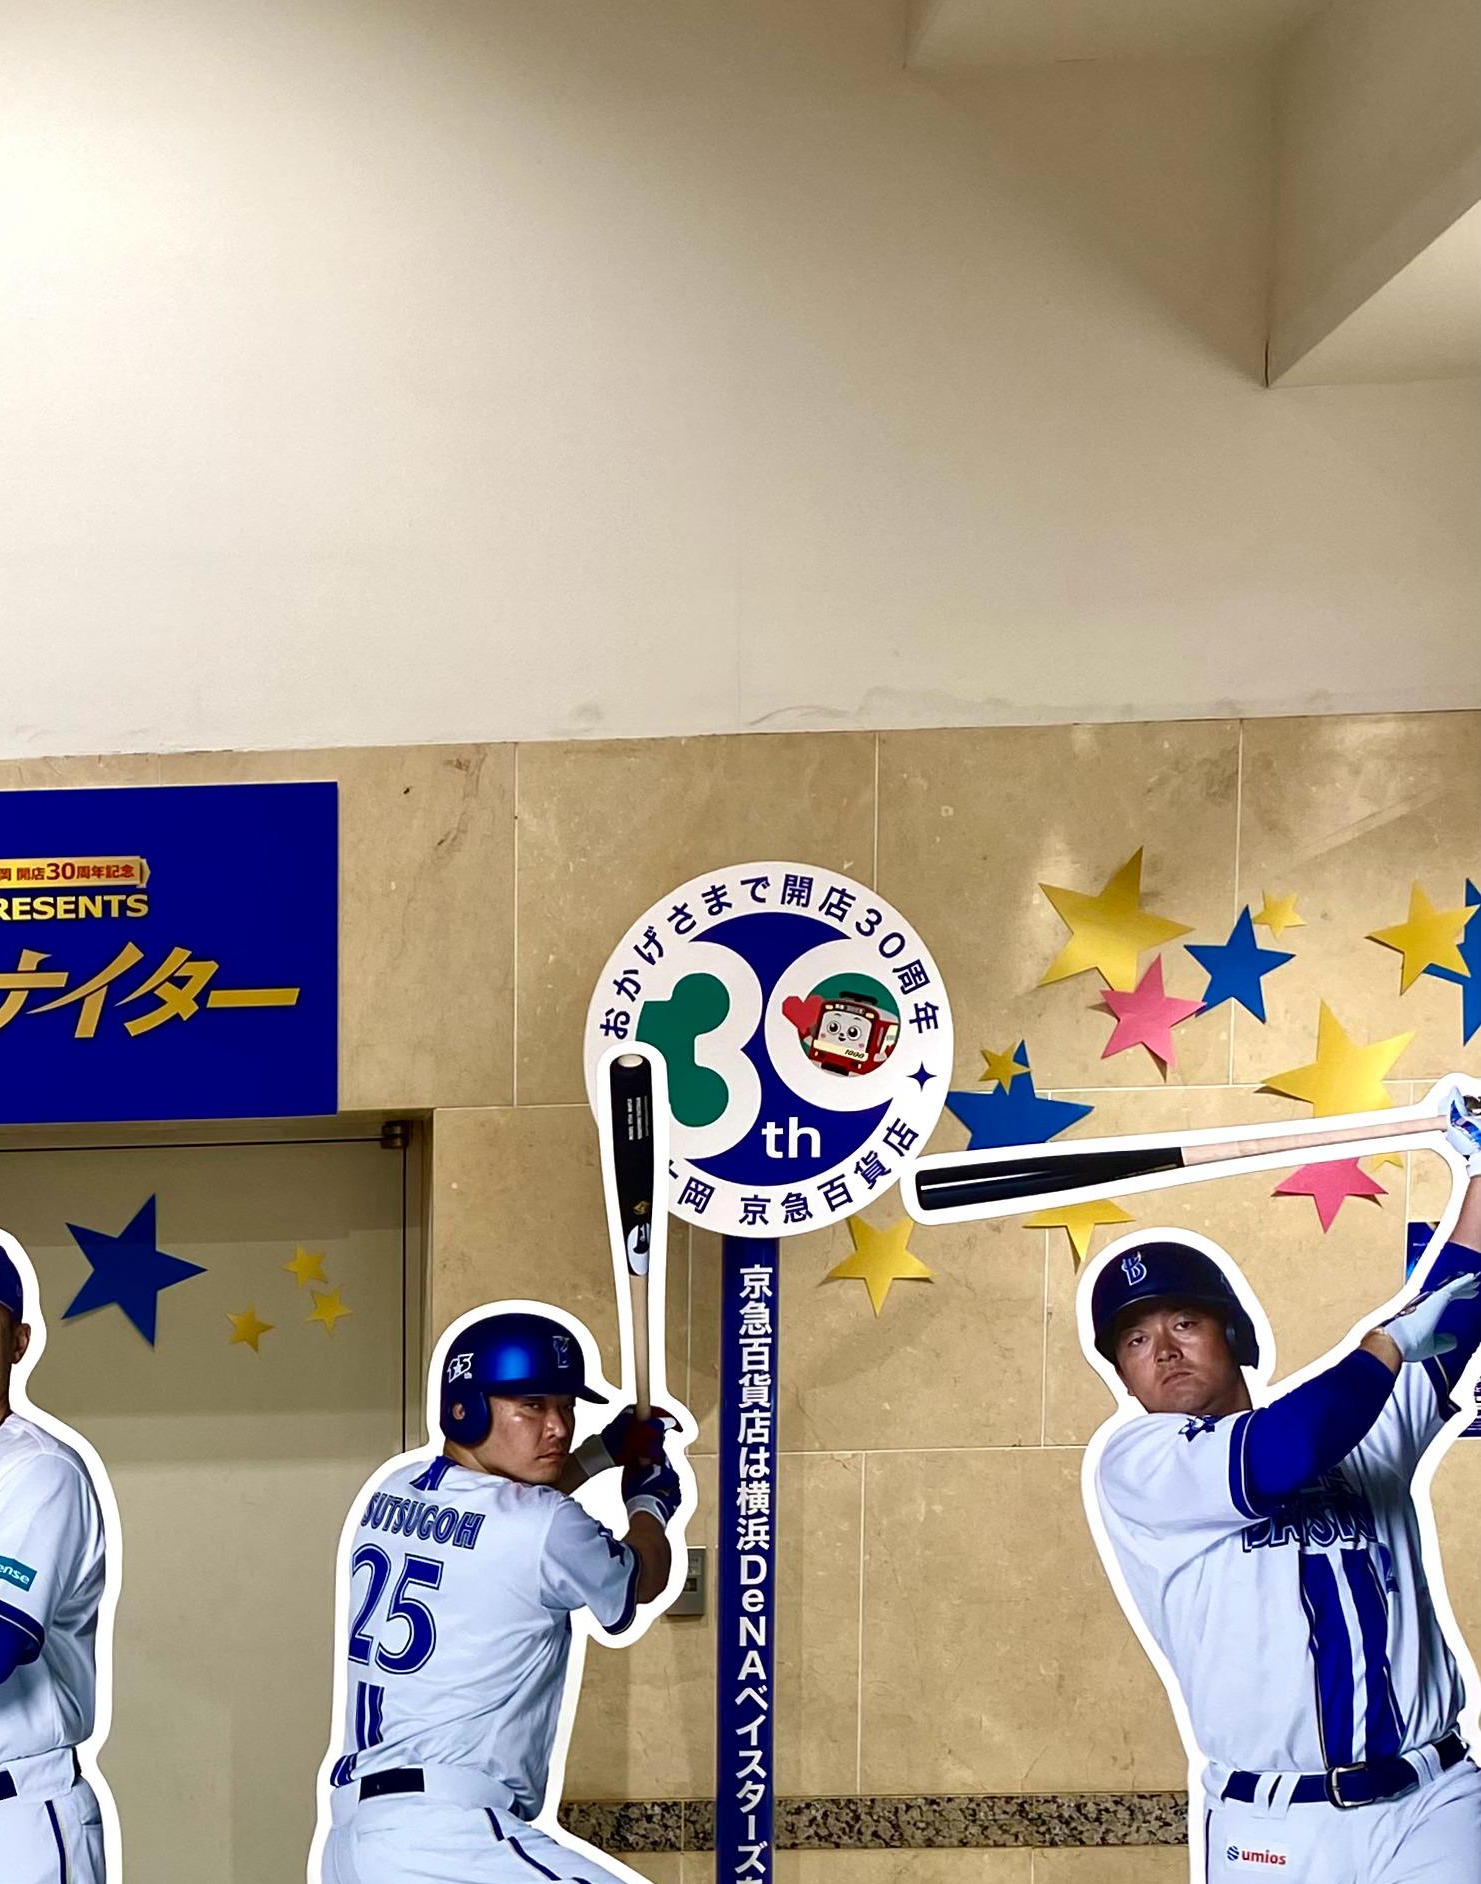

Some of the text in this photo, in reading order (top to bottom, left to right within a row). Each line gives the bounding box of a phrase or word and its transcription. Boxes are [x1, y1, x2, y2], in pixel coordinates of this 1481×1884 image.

[16, 862, 135, 882] 開店30周年記念
[347, 1543, 445, 1676] 25
[1241, 1849, 1287, 1866] umios
